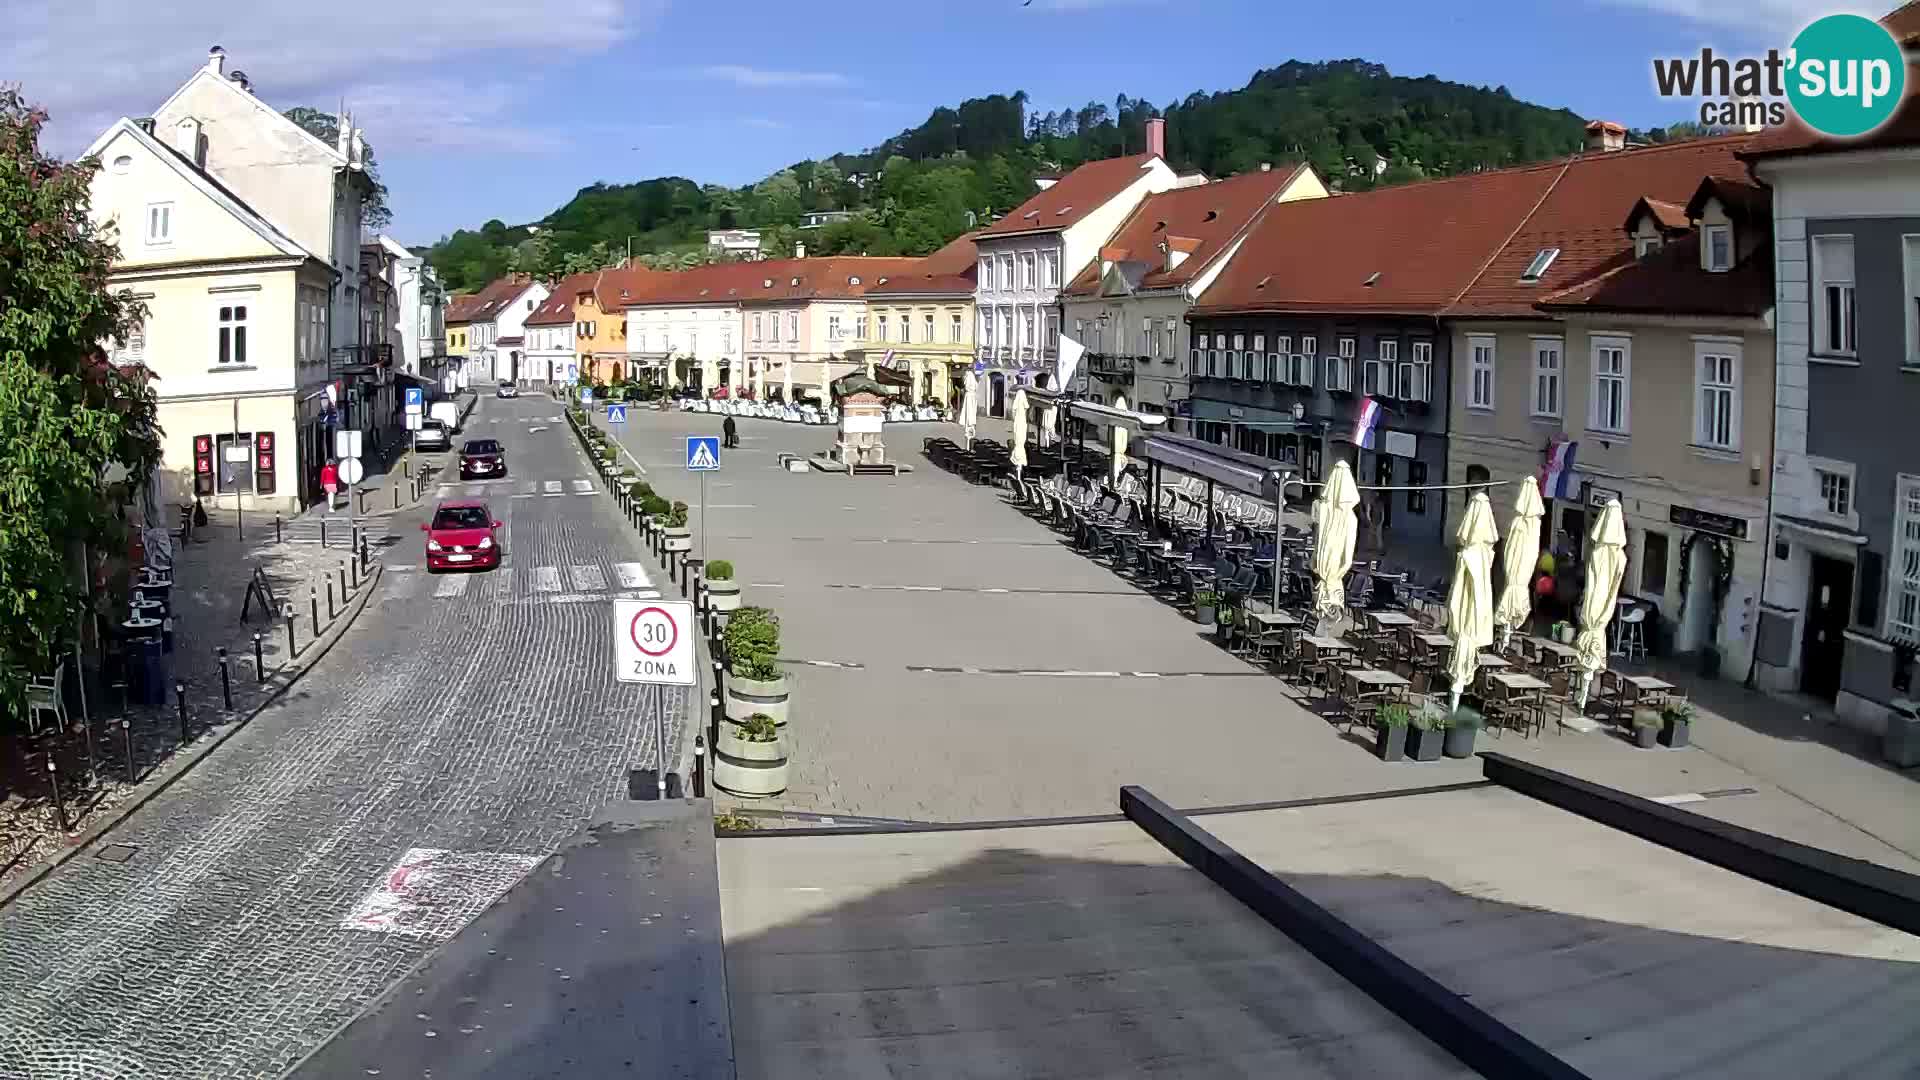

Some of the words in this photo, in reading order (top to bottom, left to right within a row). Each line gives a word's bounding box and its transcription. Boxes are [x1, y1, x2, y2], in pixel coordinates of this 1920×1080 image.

[409, 391, 418, 403] P
[643, 622, 667, 644] 30
[633, 659, 677, 676] ZONA
